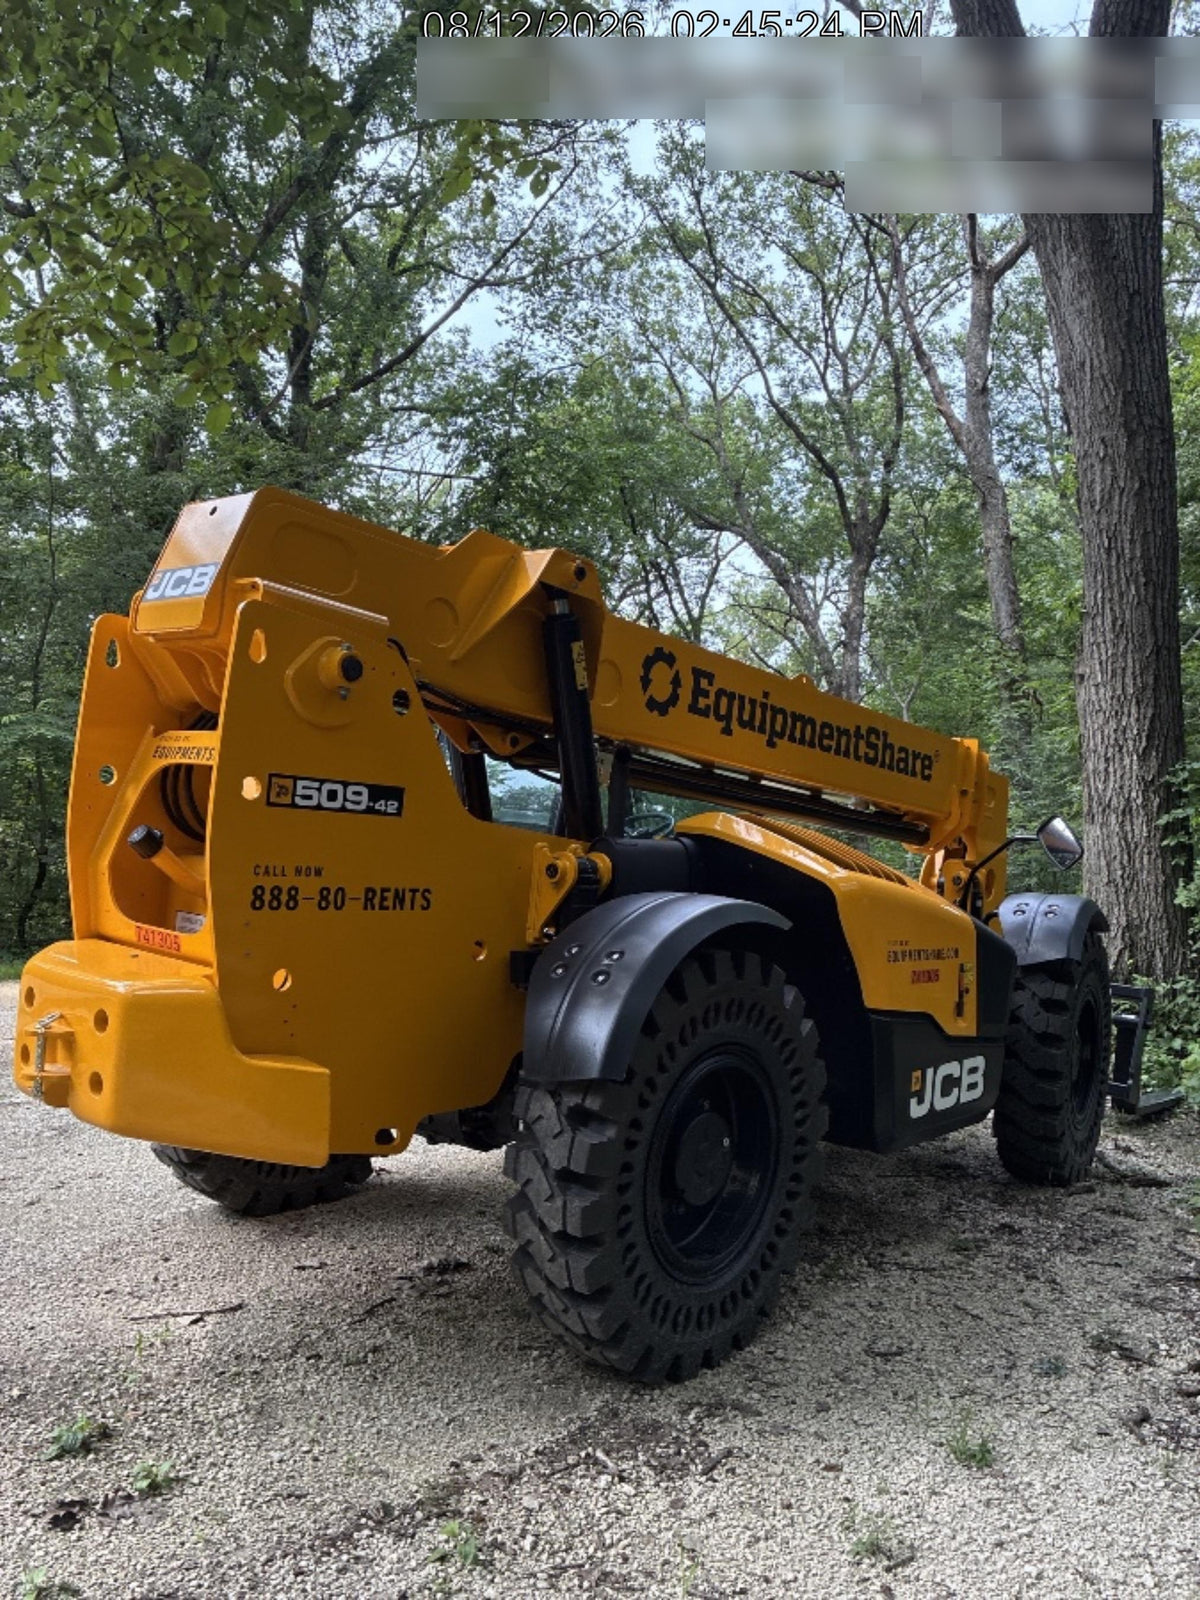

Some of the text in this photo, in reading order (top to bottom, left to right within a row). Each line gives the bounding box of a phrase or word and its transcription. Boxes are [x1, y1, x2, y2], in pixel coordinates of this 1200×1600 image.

[145, 565, 217, 600] JCB
[687, 666, 934, 782] EquipmentShare
[253, 864, 325, 878] CALL NOW
[250, 885, 432, 911] 888-80-RENTS
[909, 1055, 986, 1119] JCB
